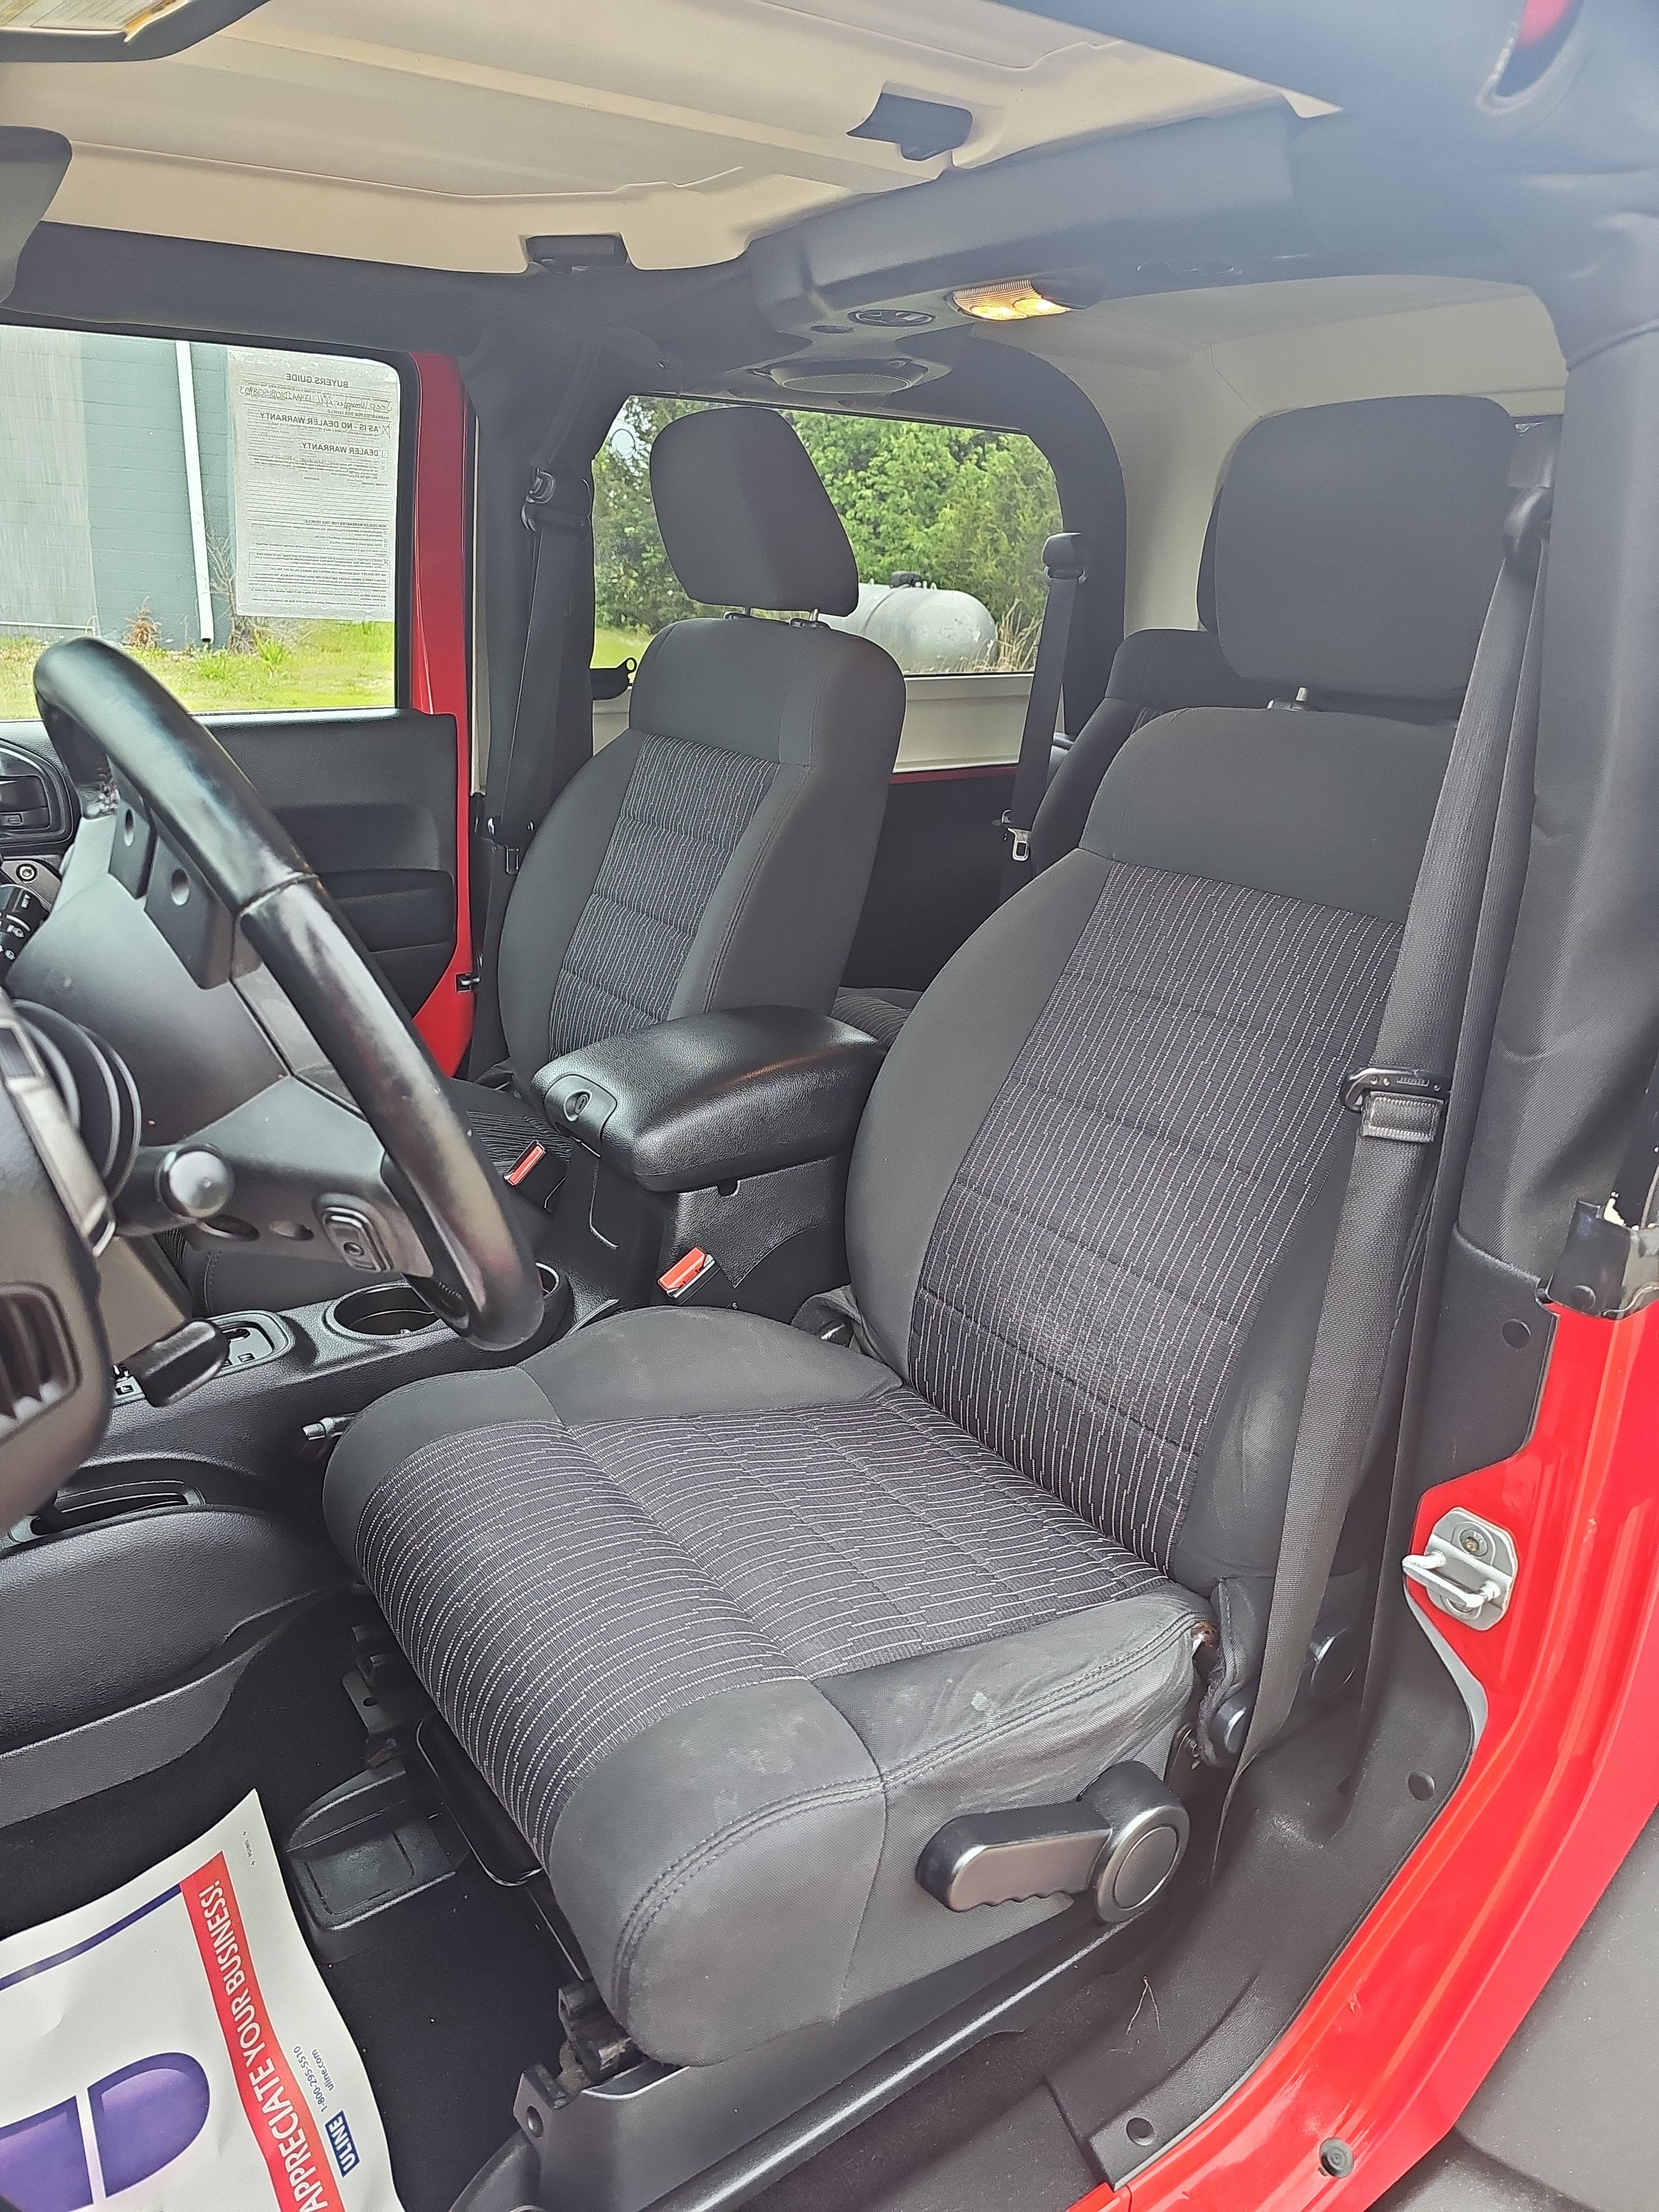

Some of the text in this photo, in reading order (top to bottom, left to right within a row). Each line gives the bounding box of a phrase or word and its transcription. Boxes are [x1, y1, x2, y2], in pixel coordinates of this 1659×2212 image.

[198, 1880, 329, 2212] APPRECIATE YOUR BUSINESS!
[312, 2048, 335, 2092] uline.com
[293, 2046, 328, 2113] 1-800-295-5510
[327, 2114, 357, 2172] ULINE
